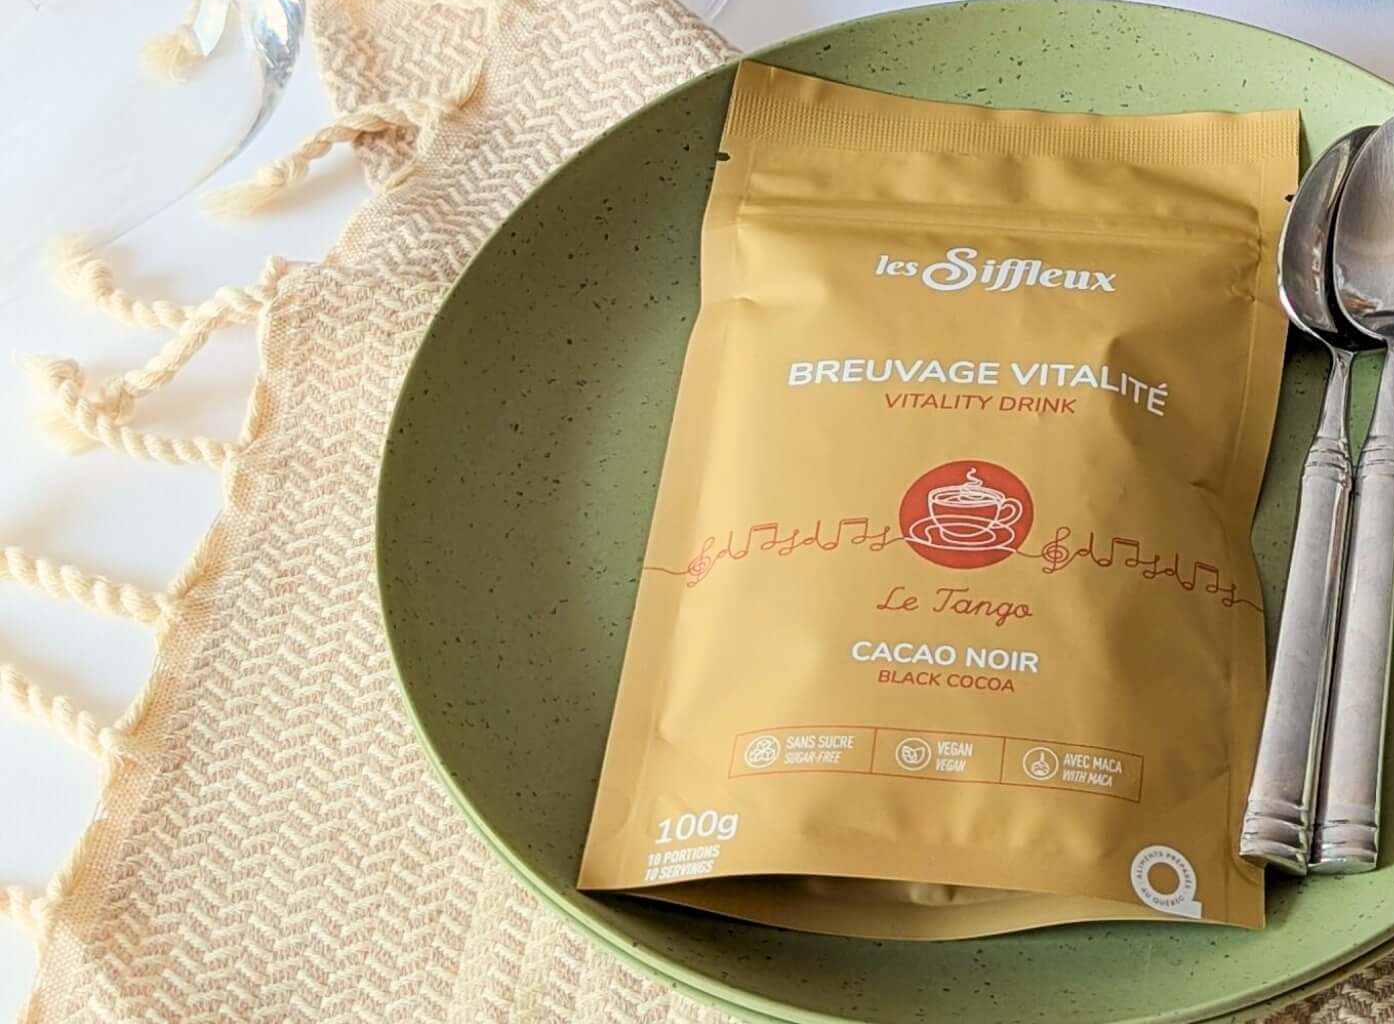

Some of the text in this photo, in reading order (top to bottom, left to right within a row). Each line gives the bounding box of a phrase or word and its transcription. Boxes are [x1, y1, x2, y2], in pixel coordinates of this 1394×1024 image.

[875, 247, 1117, 293] les Siffleux
[787, 359, 1169, 417] BREUVAGE VITALITÉ
[884, 392, 1077, 415] VITALITY DRINK
[876, 586, 1033, 627] Le Tango
[852, 640, 1039, 673] CACAO NOIR
[878, 669, 1015, 693] BLACK COCOA
[786, 736, 855, 750] SANS SUCRE
[784, 751, 841, 764] SUGAR-FREE
[935, 758, 967, 772] VEGAN
[1063, 752, 1122, 774] AVEC MACA
[1062, 770, 1113, 787] WITH MACA
[656, 810, 739, 844] 100g
[663, 844, 720, 865] PORTIONS
[659, 859, 715, 879] SERVINGS
